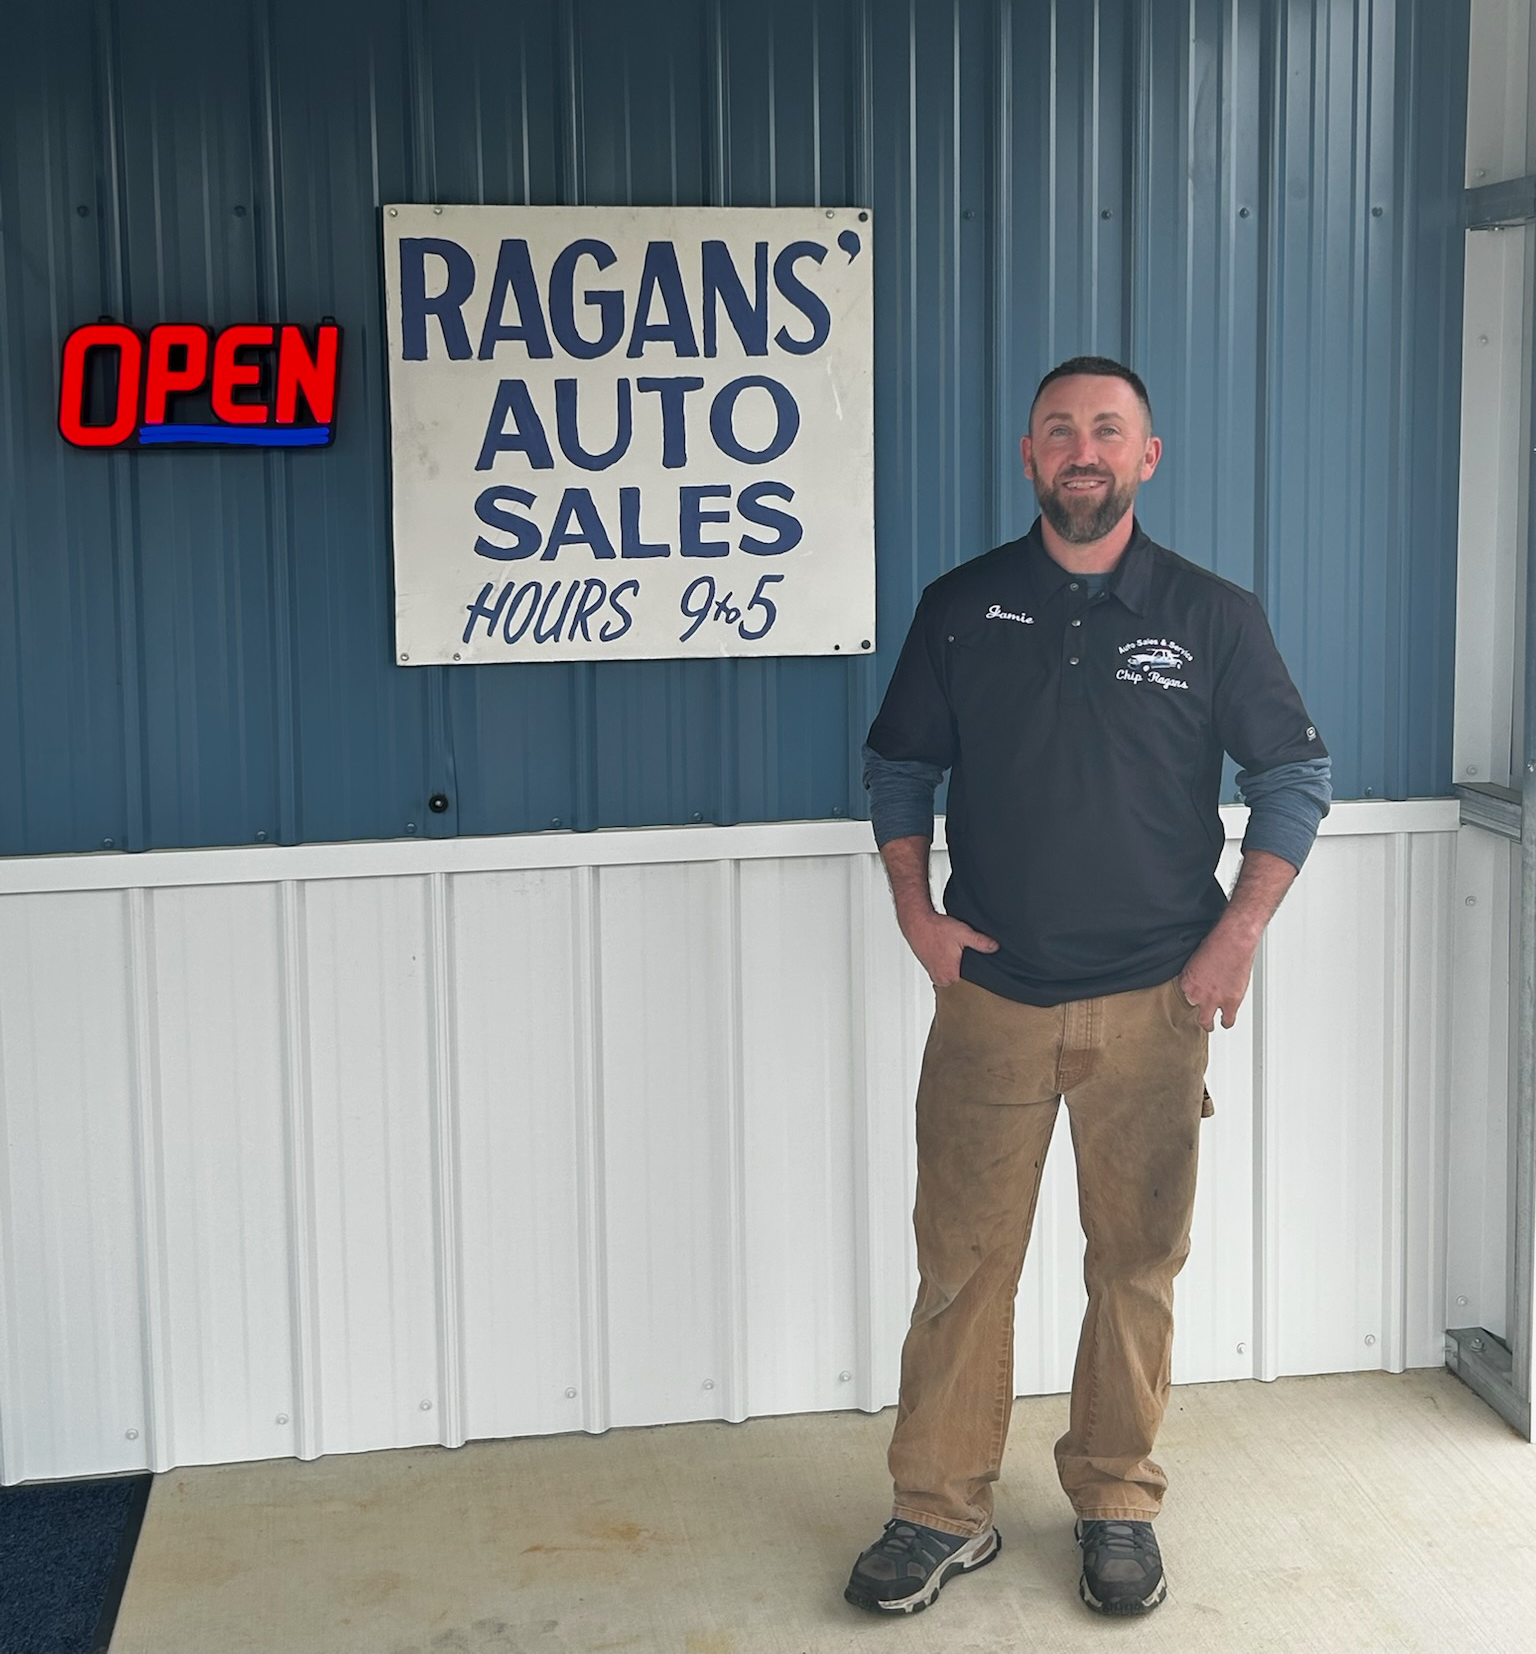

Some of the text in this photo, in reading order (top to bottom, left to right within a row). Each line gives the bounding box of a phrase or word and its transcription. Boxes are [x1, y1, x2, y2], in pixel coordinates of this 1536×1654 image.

[399, 230, 861, 360] RAGANS'
[60, 324, 338, 446] OPEN
[475, 374, 800, 471] AUTO
[474, 481, 803, 561] SALES
[462, 578, 640, 645] HOURS
[985, 604, 1035, 624] Jamie
[1115, 668, 1189, 690] Chip Ragans
[1118, 638, 1194, 661] Auto Sales & Service
